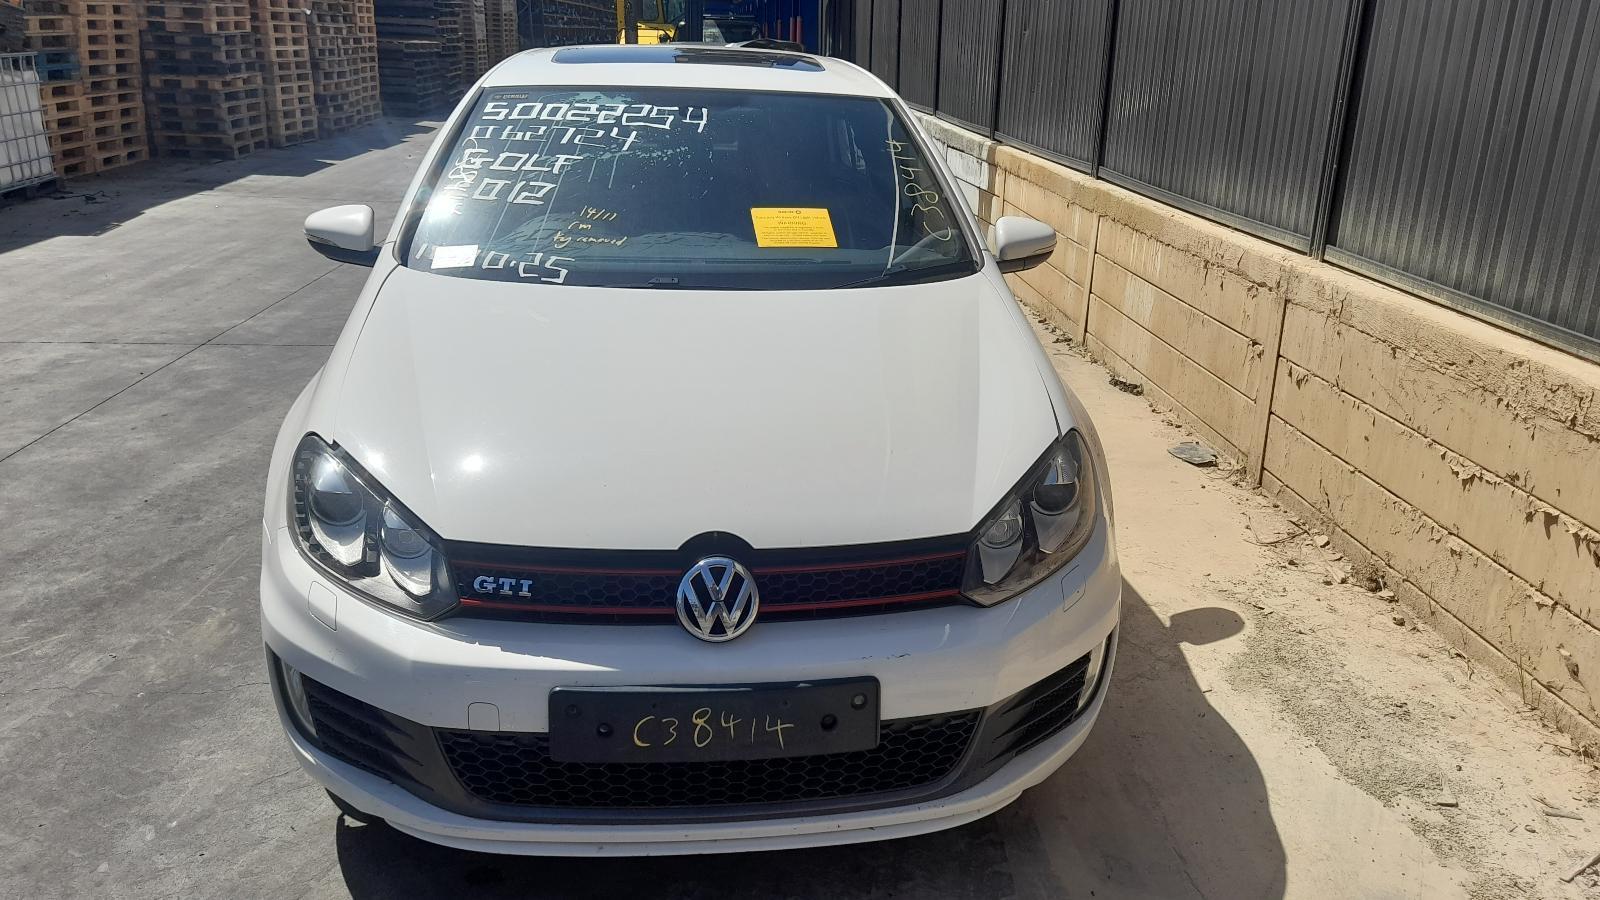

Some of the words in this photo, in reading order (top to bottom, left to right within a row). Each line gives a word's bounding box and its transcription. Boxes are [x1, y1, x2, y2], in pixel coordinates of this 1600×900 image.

[463, 148, 584, 174] GOLF
[473, 574, 533, 598] GTI
[633, 707, 795, 750] C38414
